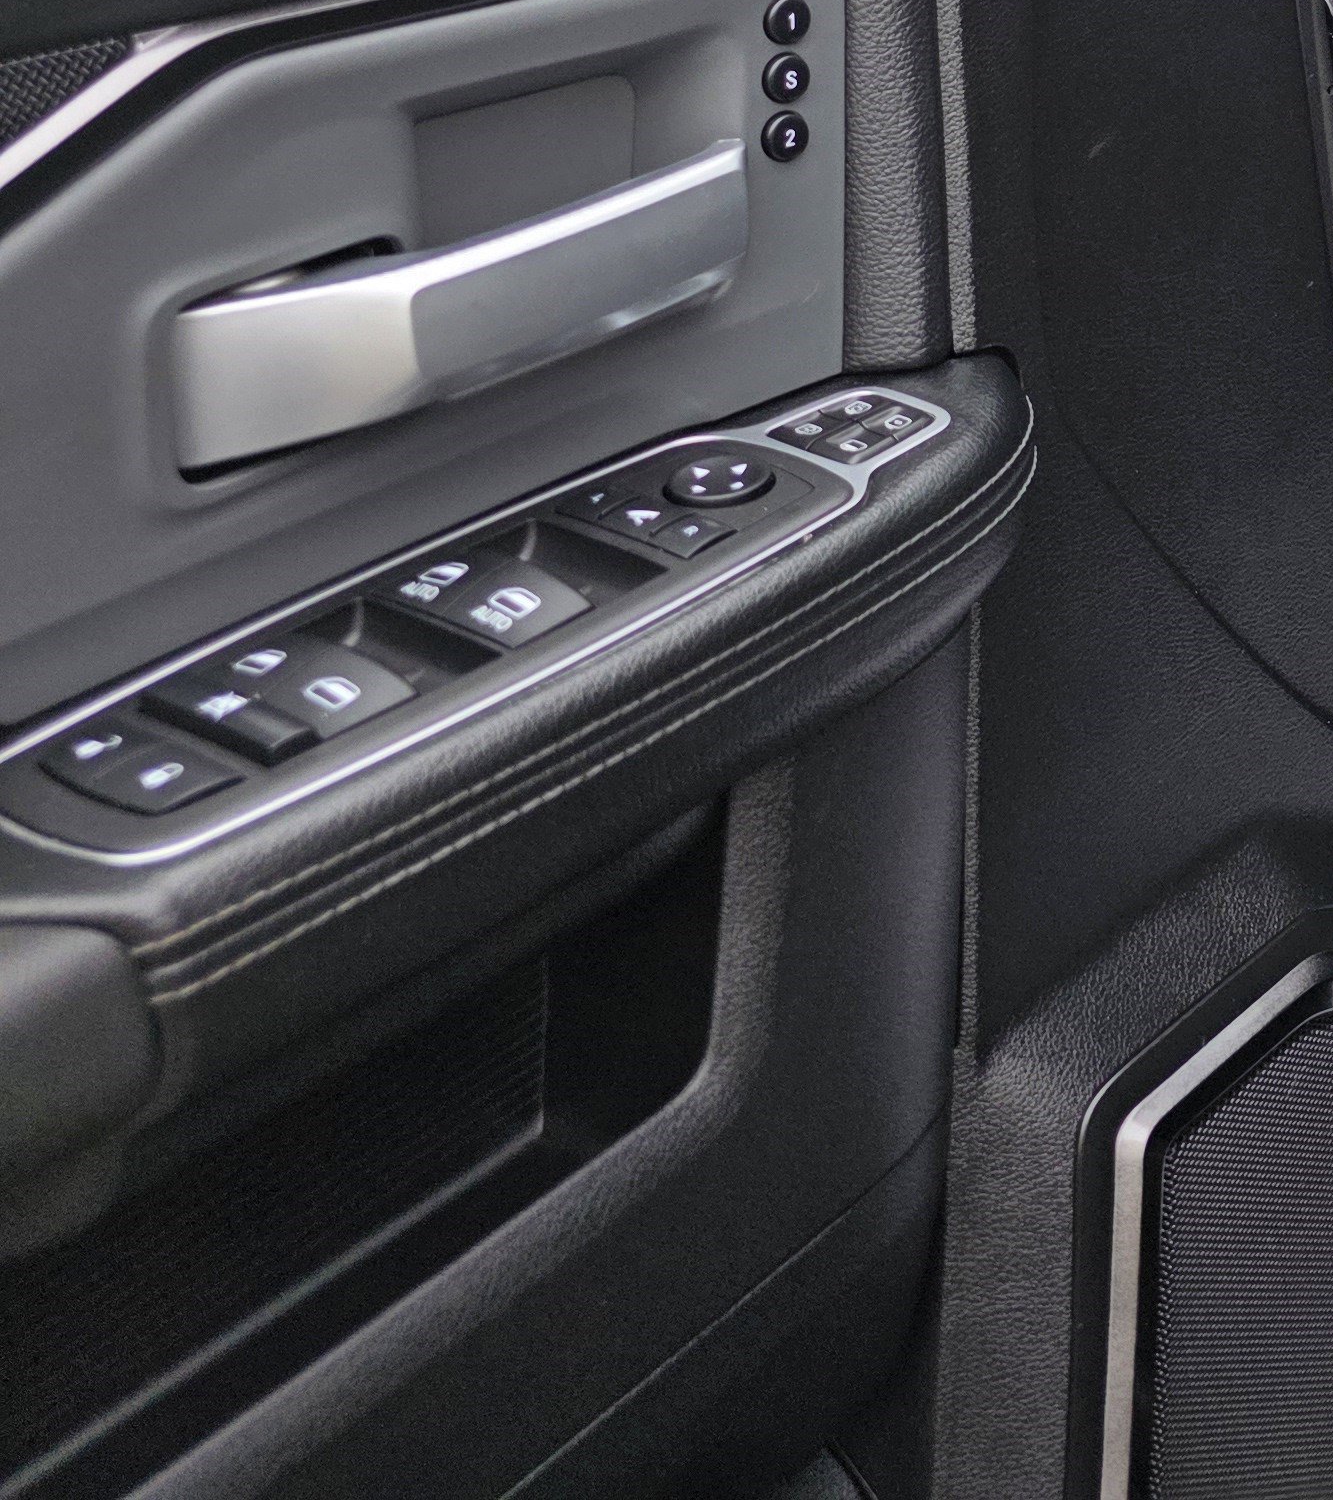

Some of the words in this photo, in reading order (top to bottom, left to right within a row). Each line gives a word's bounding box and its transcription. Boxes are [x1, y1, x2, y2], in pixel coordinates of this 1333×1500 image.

[788, 13, 796, 31] 1
[785, 71, 798, 90] S
[785, 129, 796, 148] 2
[400, 581, 440, 603] AUTO
[470, 605, 513, 633] AUTO
